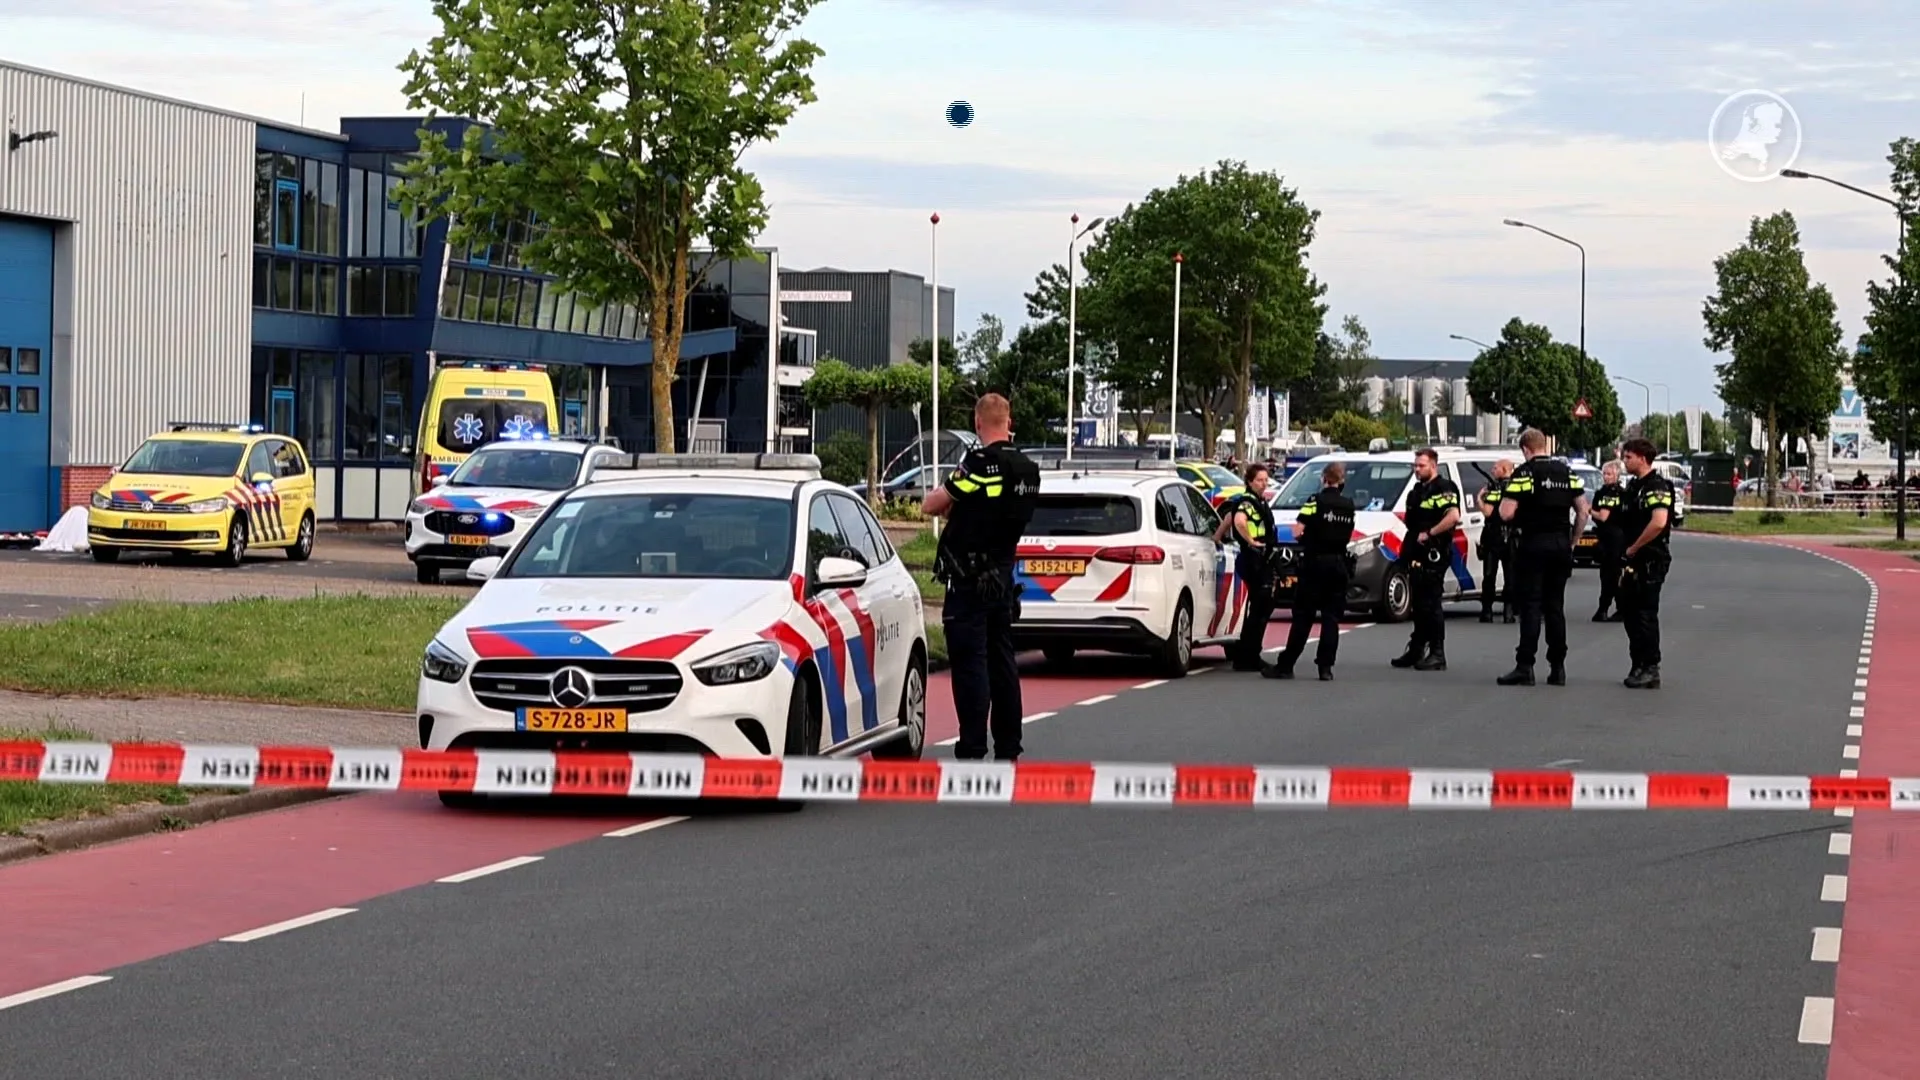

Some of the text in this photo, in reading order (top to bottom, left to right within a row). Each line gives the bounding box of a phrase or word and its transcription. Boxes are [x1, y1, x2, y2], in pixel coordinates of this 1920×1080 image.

[432, 455, 463, 463] AMBUL
[1029, 561, 1079, 573] S-152-LF
[536, 605, 658, 614] POLITIE
[532, 711, 615, 728] S-728-JR
[46, 757, 100, 776] NIET
[201, 761, 327, 779] BETREDEN
[336, 764, 390, 782] NIET
[496, 767, 627, 786] BETREDEN
[636, 769, 692, 788] NIET
[801, 773, 936, 792] BETREDEN
[943, 773, 1002, 795] NIET
